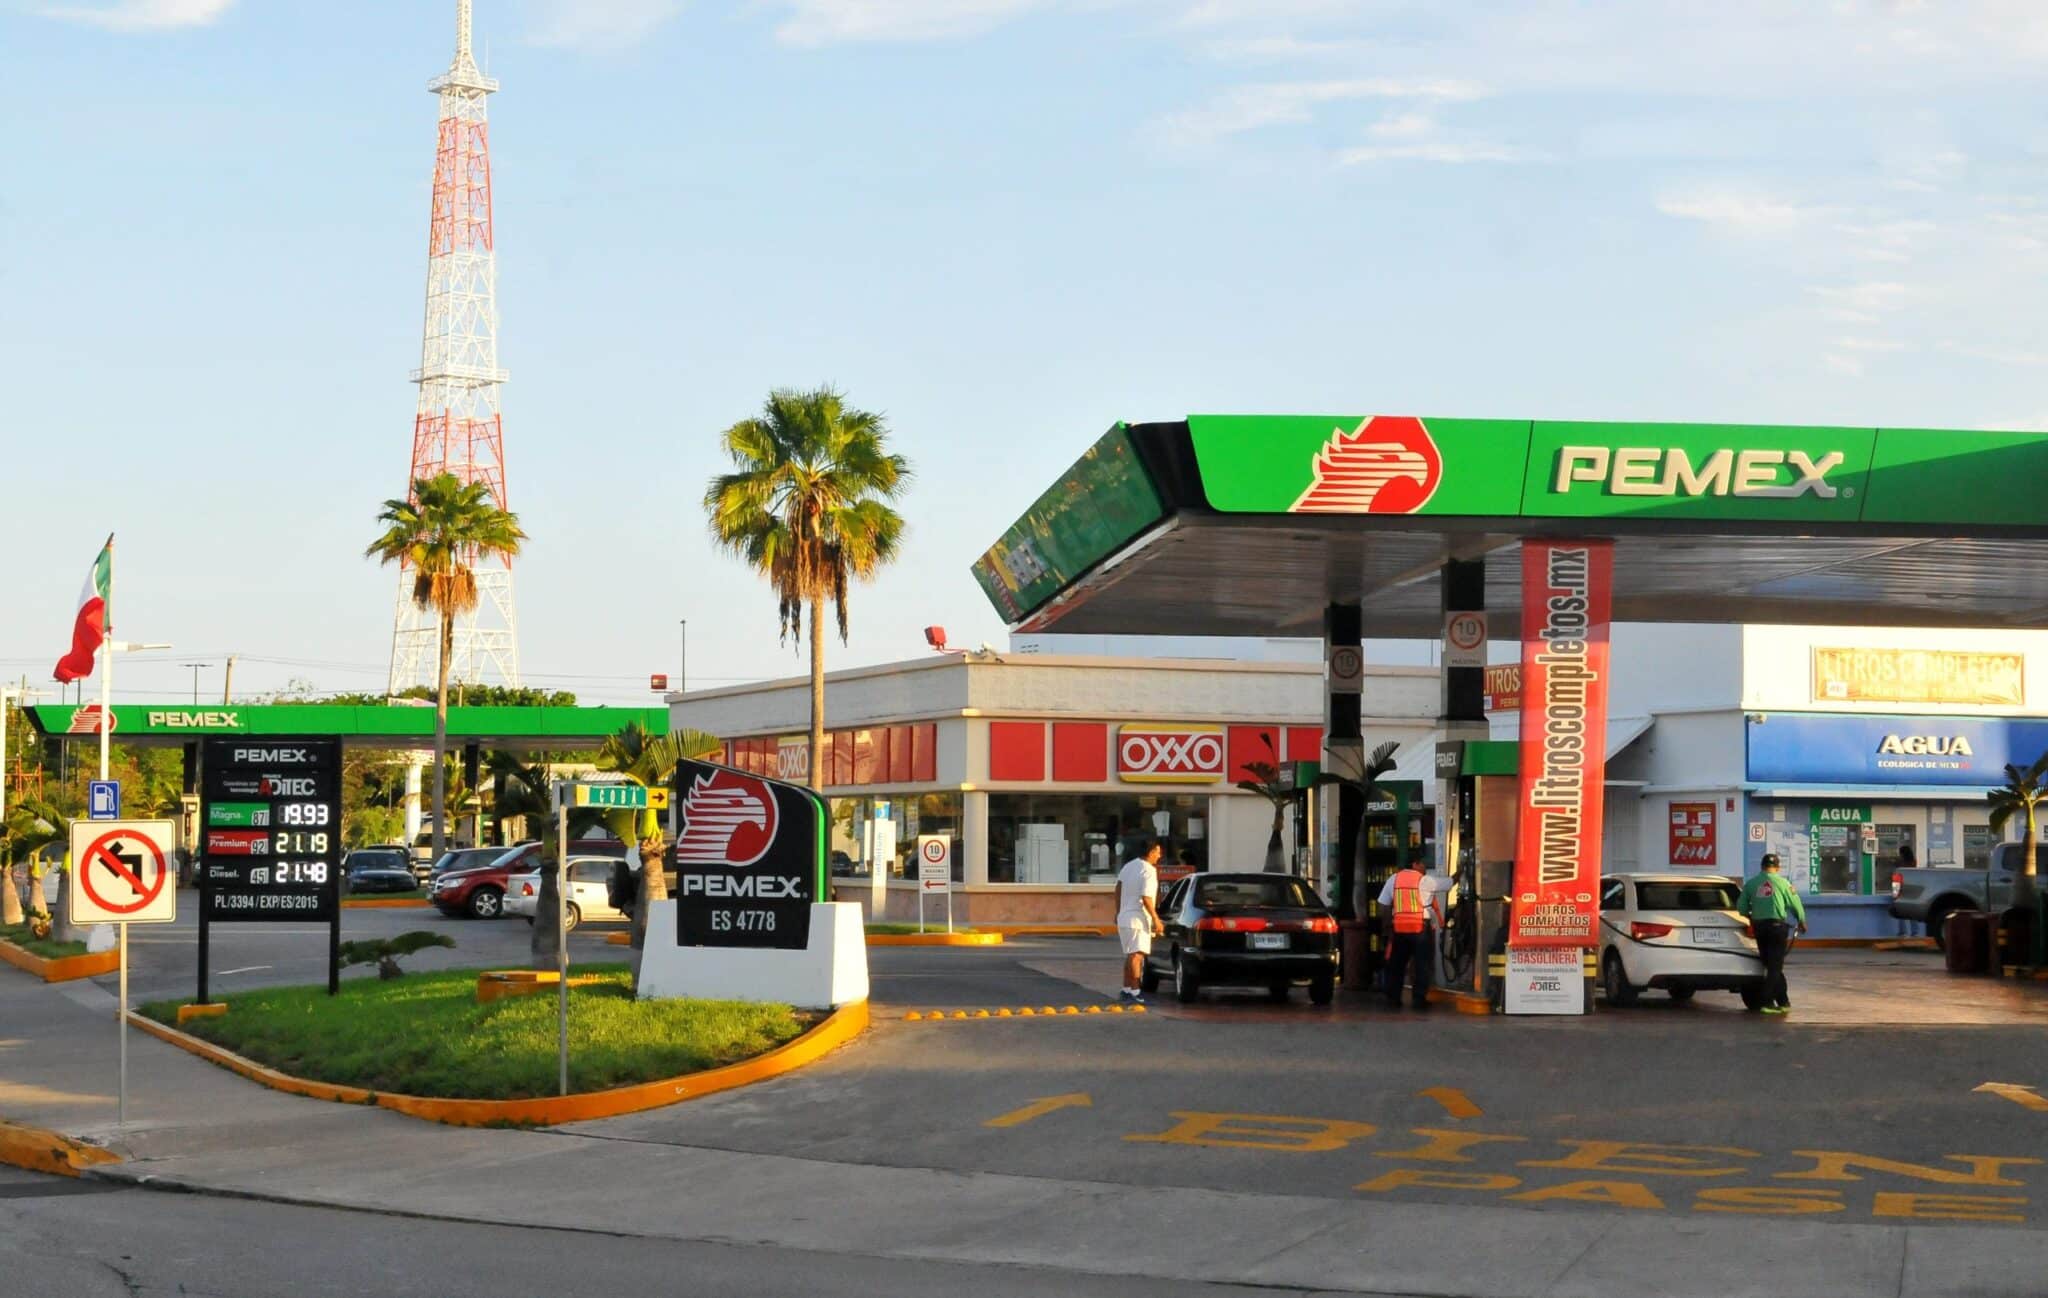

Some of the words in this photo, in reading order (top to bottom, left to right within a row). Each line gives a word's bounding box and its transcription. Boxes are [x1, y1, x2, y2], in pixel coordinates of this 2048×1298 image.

[1556, 446, 1845, 498] PEMEX
[1454, 620, 1477, 636] 10
[1484, 668, 1521, 695] ITROS
[148, 711, 239, 727] PEMEX
[1534, 548, 1596, 882] www.litroscompletos.mx
[234, 748, 307, 763] PEMEX
[1122, 736, 1222, 770] OXXO
[1878, 735, 1973, 755] AGUA
[778, 745, 809, 778] OXXO
[1437, 751, 1457, 768] PEMEX
[209, 811, 241, 821] Magna
[252, 811, 264, 825] 87
[284, 804, 329, 825] 19.93
[1367, 801, 1395, 812] PEMEX
[1821, 808, 1861, 821] AGUA
[209, 839, 248, 848] Premium
[252, 841, 265, 854] 92
[275, 832, 328, 853] 21.19
[929, 844, 940, 855] 10
[1810, 824, 1819, 892] ALCALINA
[209, 868, 239, 878] Diesel
[275, 862, 328, 883] 21.48
[683, 874, 801, 898] PEMEX
[711, 910, 731, 931] ES
[736, 910, 776, 931] 4778
[1519, 914, 1590, 927] COMPLETOS
[1535, 904, 1577, 916] LITROS
[1517, 952, 1578, 965] GASOLINERA
[1120, 1110, 2044, 1187] BIEN
[1352, 1168, 2029, 1222] PASE
